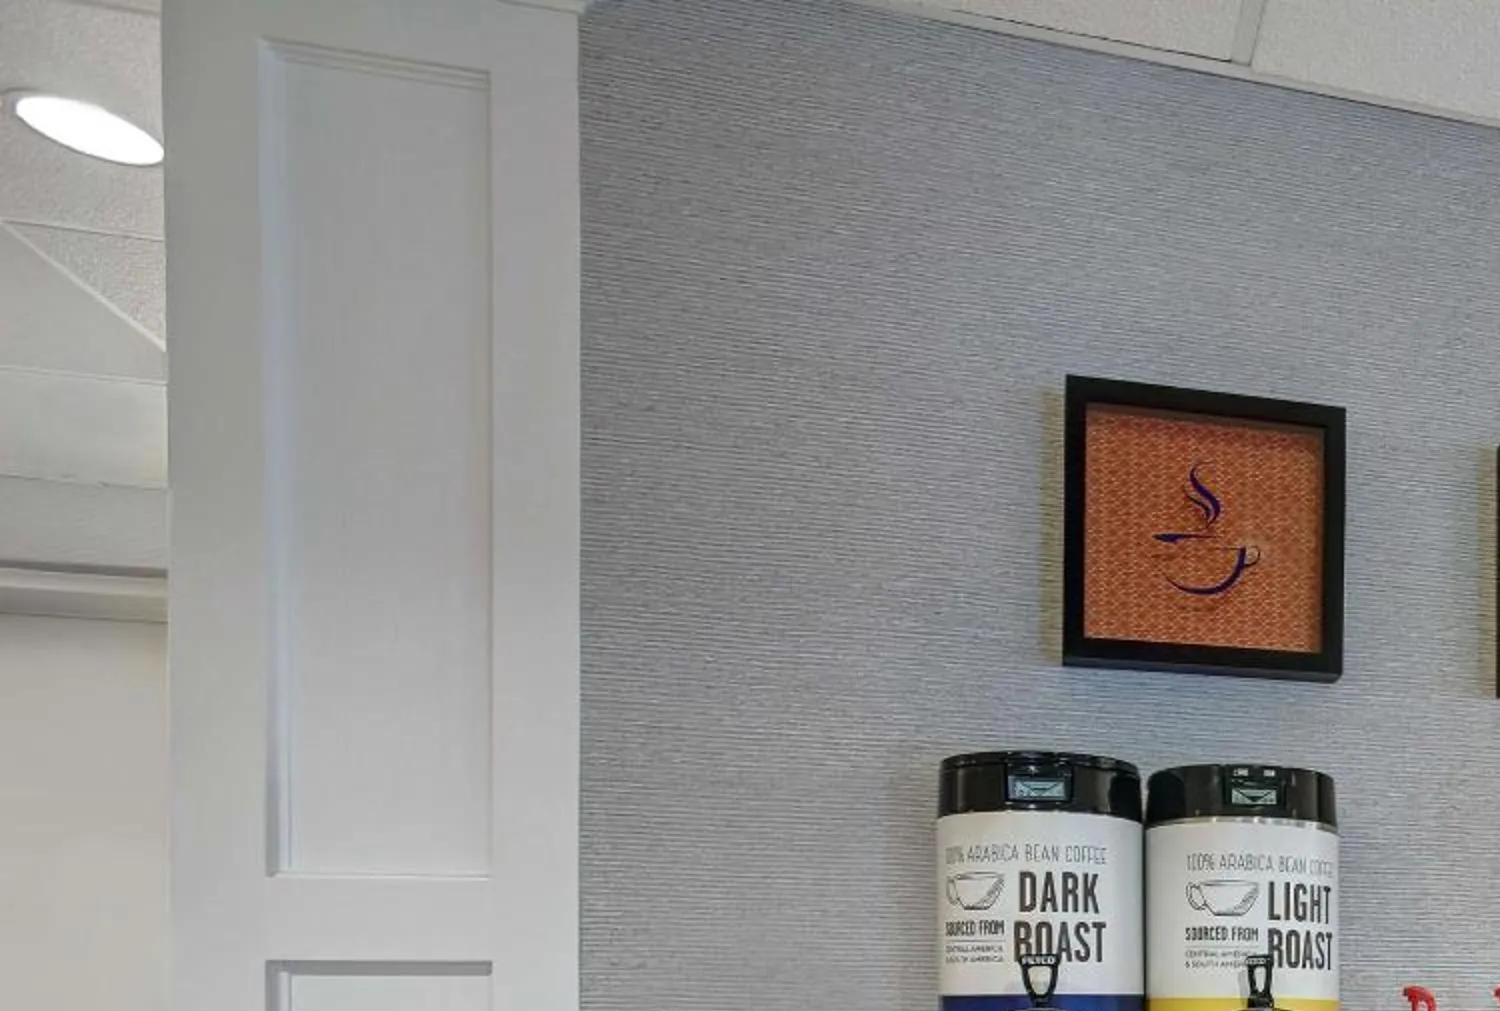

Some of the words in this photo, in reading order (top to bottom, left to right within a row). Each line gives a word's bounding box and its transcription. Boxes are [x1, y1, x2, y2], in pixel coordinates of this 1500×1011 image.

[1025, 843, 1059, 862] BEAN
[1219, 853, 1274, 871] ARABICA
[1278, 855, 1307, 874] BEAN
[1018, 871, 1100, 914] DARK
[1268, 881, 1331, 924] LIGHT
[979, 919, 1005, 936] FROM
[1013, 921, 1107, 963] ROAST
[1185, 926, 1228, 941] SOURCED
[1231, 927, 1259, 941] FROM
[1267, 927, 1333, 970] ROAST
